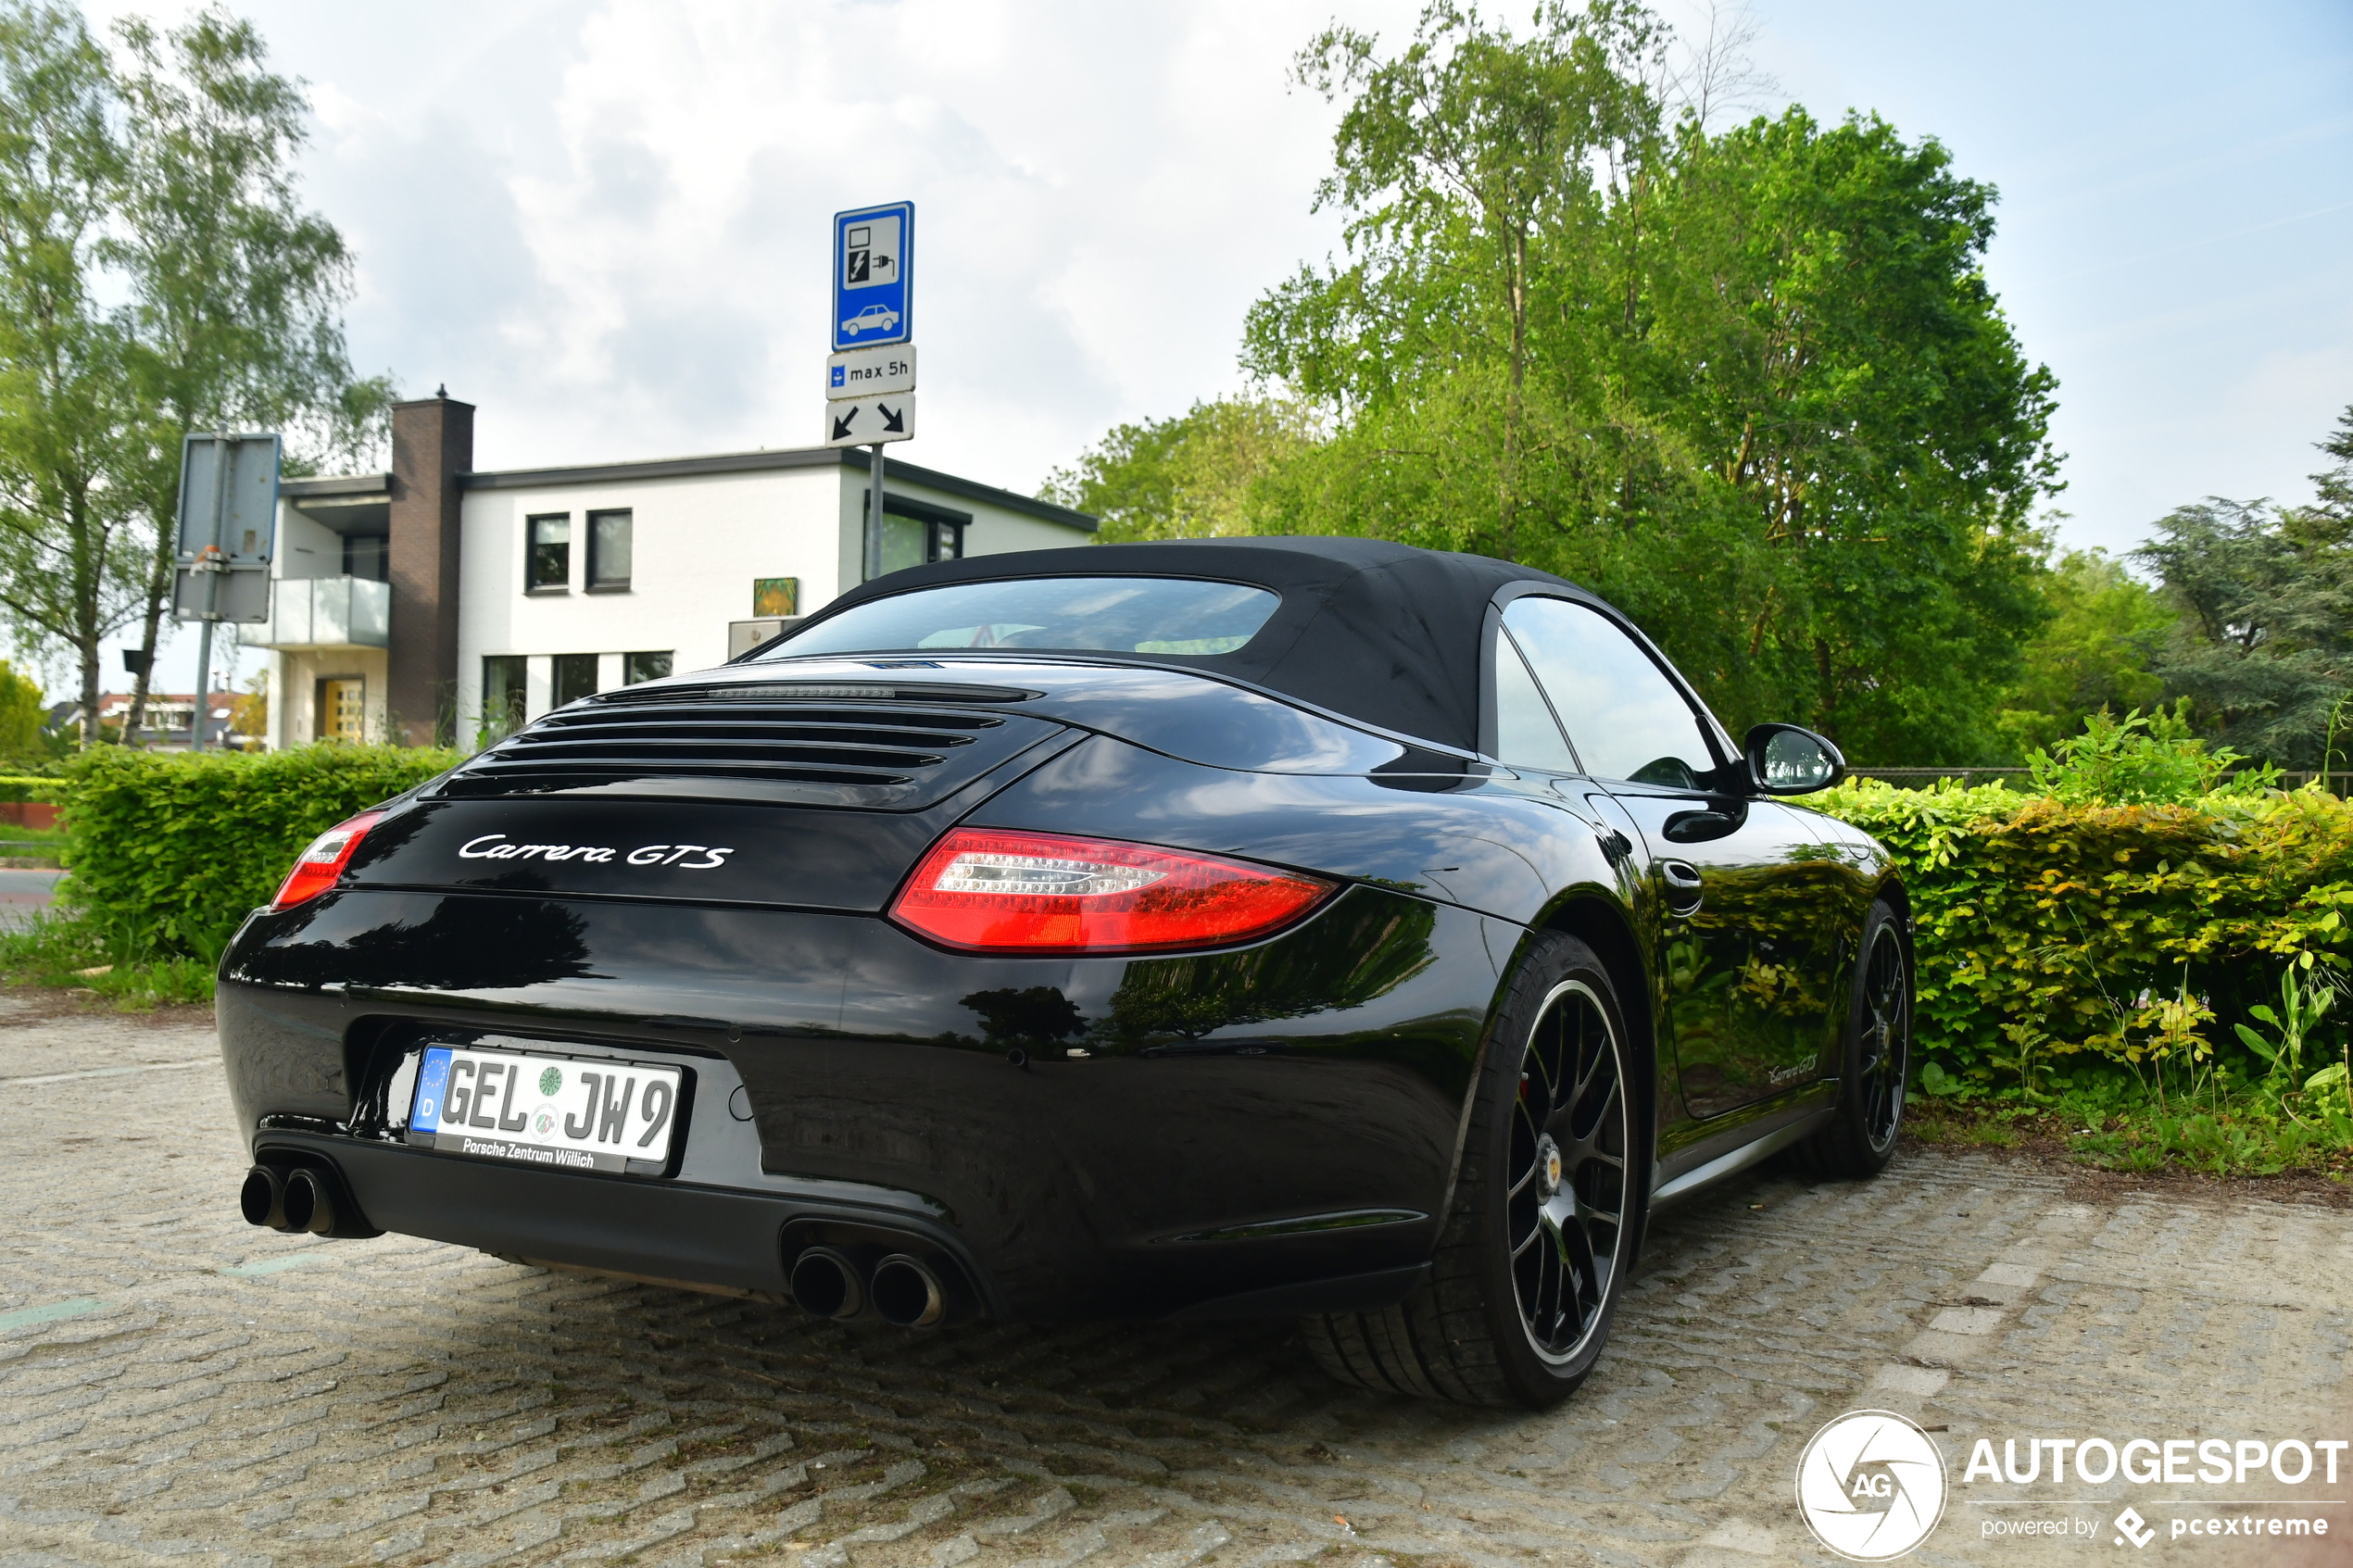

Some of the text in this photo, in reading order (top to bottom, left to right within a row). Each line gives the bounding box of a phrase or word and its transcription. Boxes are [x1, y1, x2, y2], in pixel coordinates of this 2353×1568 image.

[850, 360, 908, 381] max 5h
[459, 834, 736, 870] Carrera GTS
[421, 1098, 434, 1117] D
[441, 1059, 528, 1132] GEL
[462, 1137, 595, 1169] Porsche Zentrum Willich
